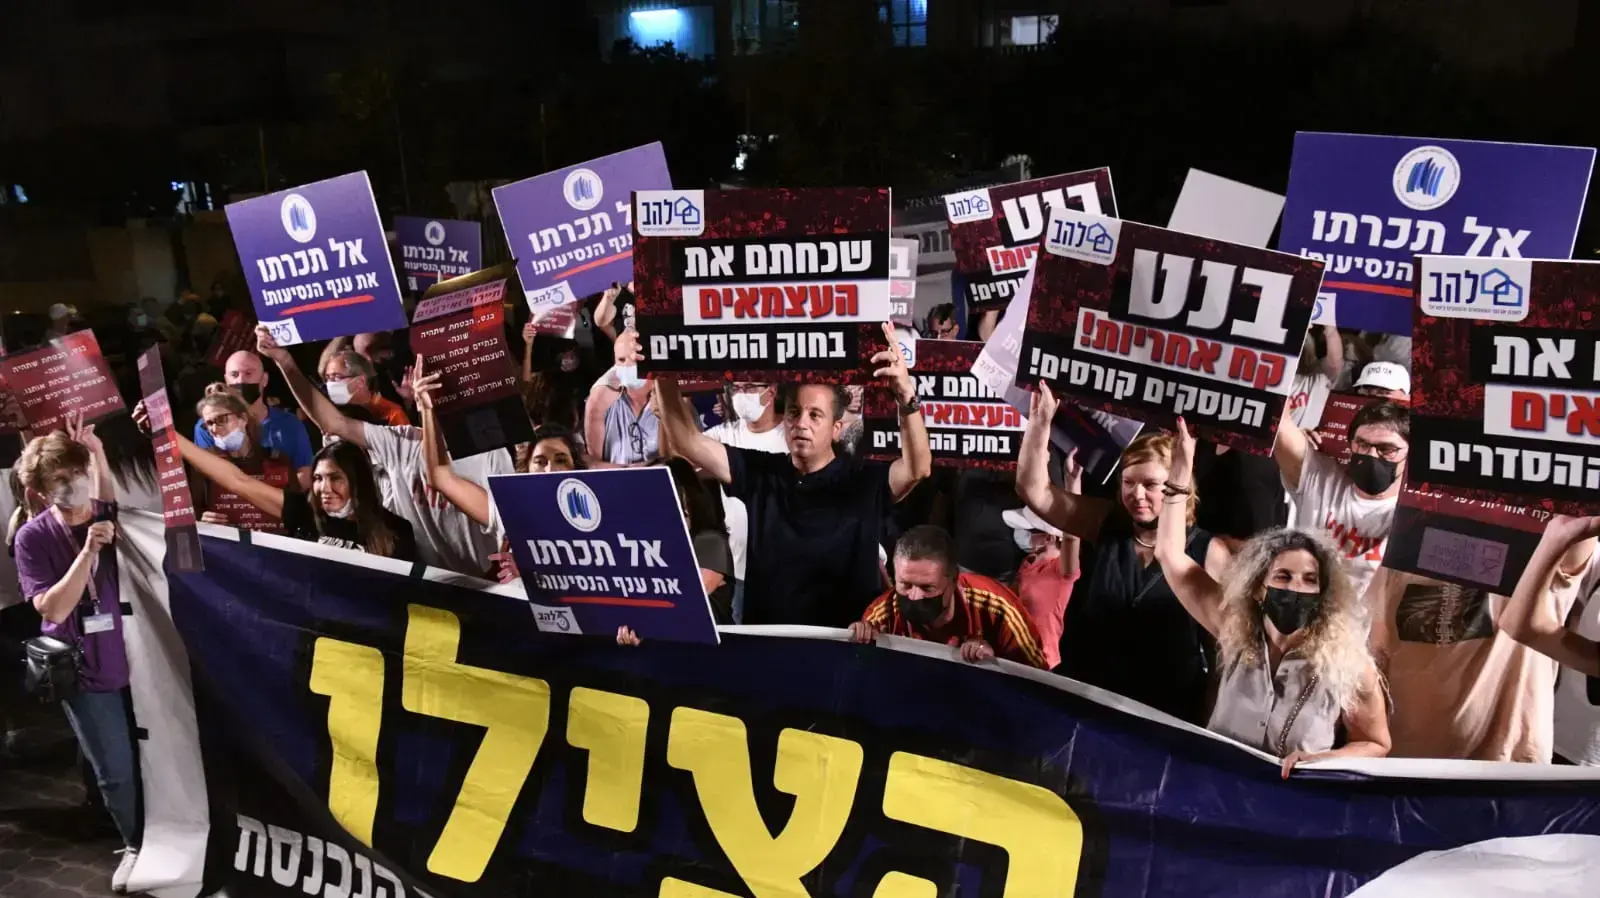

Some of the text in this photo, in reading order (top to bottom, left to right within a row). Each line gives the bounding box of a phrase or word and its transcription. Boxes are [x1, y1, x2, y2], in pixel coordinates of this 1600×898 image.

[615, 201, 632, 226] ל
[642, 199, 672, 225] להב
[528, 211, 613, 254] תכרתו
[1051, 219, 1087, 248] להב
[1311, 210, 1532, 257] אל תכרתו
[256, 237, 368, 283] אל תכרתו
[403, 245, 469, 263] אל תכרתו
[532, 242, 605, 275] הנסיעות!
[685, 246, 734, 277] את
[746, 240, 872, 275] שכחתם
[262, 281, 324, 306] הנסיעות!
[326, 275, 353, 299] ענף
[357, 271, 379, 290] את
[970, 278, 1023, 302] רסים!
[1128, 248, 1294, 345] בנט
[1428, 270, 1479, 304] להב
[533, 291, 551, 304] להב
[699, 284, 858, 320] העצמאים
[650, 332, 846, 363] בחוק ההסדרים
[1080, 311, 1223, 373] אחריות!
[1491, 336, 1577, 379] את
[1029, 346, 1137, 400] קורסים!
[1228, 346, 1287, 390] קח
[943, 376, 997, 398] חתם
[1143, 376, 1267, 428] העסקים
[962, 435, 1011, 455] בחוק
[527, 533, 668, 568] אל תכרתו
[534, 571, 681, 597] את ענף הנסיעות!
[537, 610, 556, 621] להב
[309, 603, 1086, 898] הצילו
